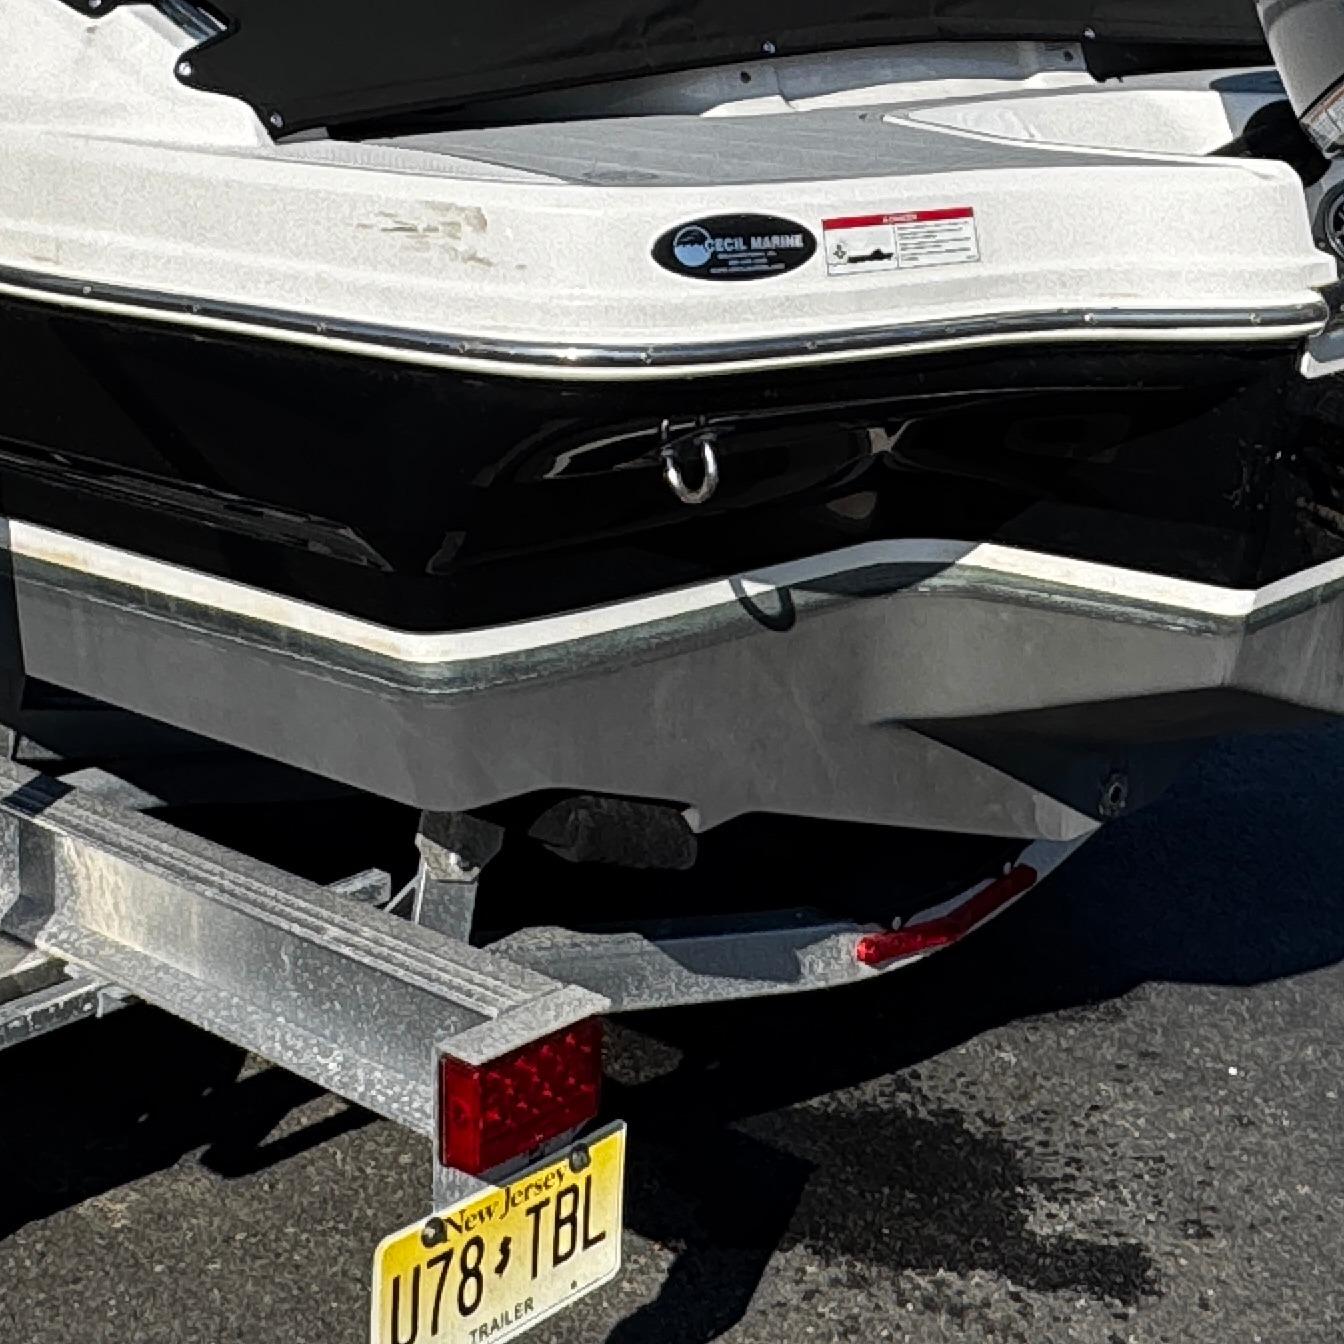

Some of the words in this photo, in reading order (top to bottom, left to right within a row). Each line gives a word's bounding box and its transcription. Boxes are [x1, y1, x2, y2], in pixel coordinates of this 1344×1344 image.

[704, 237, 748, 252] CECIL
[751, 234, 804, 250] MARINE
[444, 1200, 498, 1234] New
[499, 1164, 568, 1220] Jersey
[391, 1234, 485, 1344] U78
[526, 1174, 606, 1281] TBL
[469, 1296, 535, 1344] TRAILER
